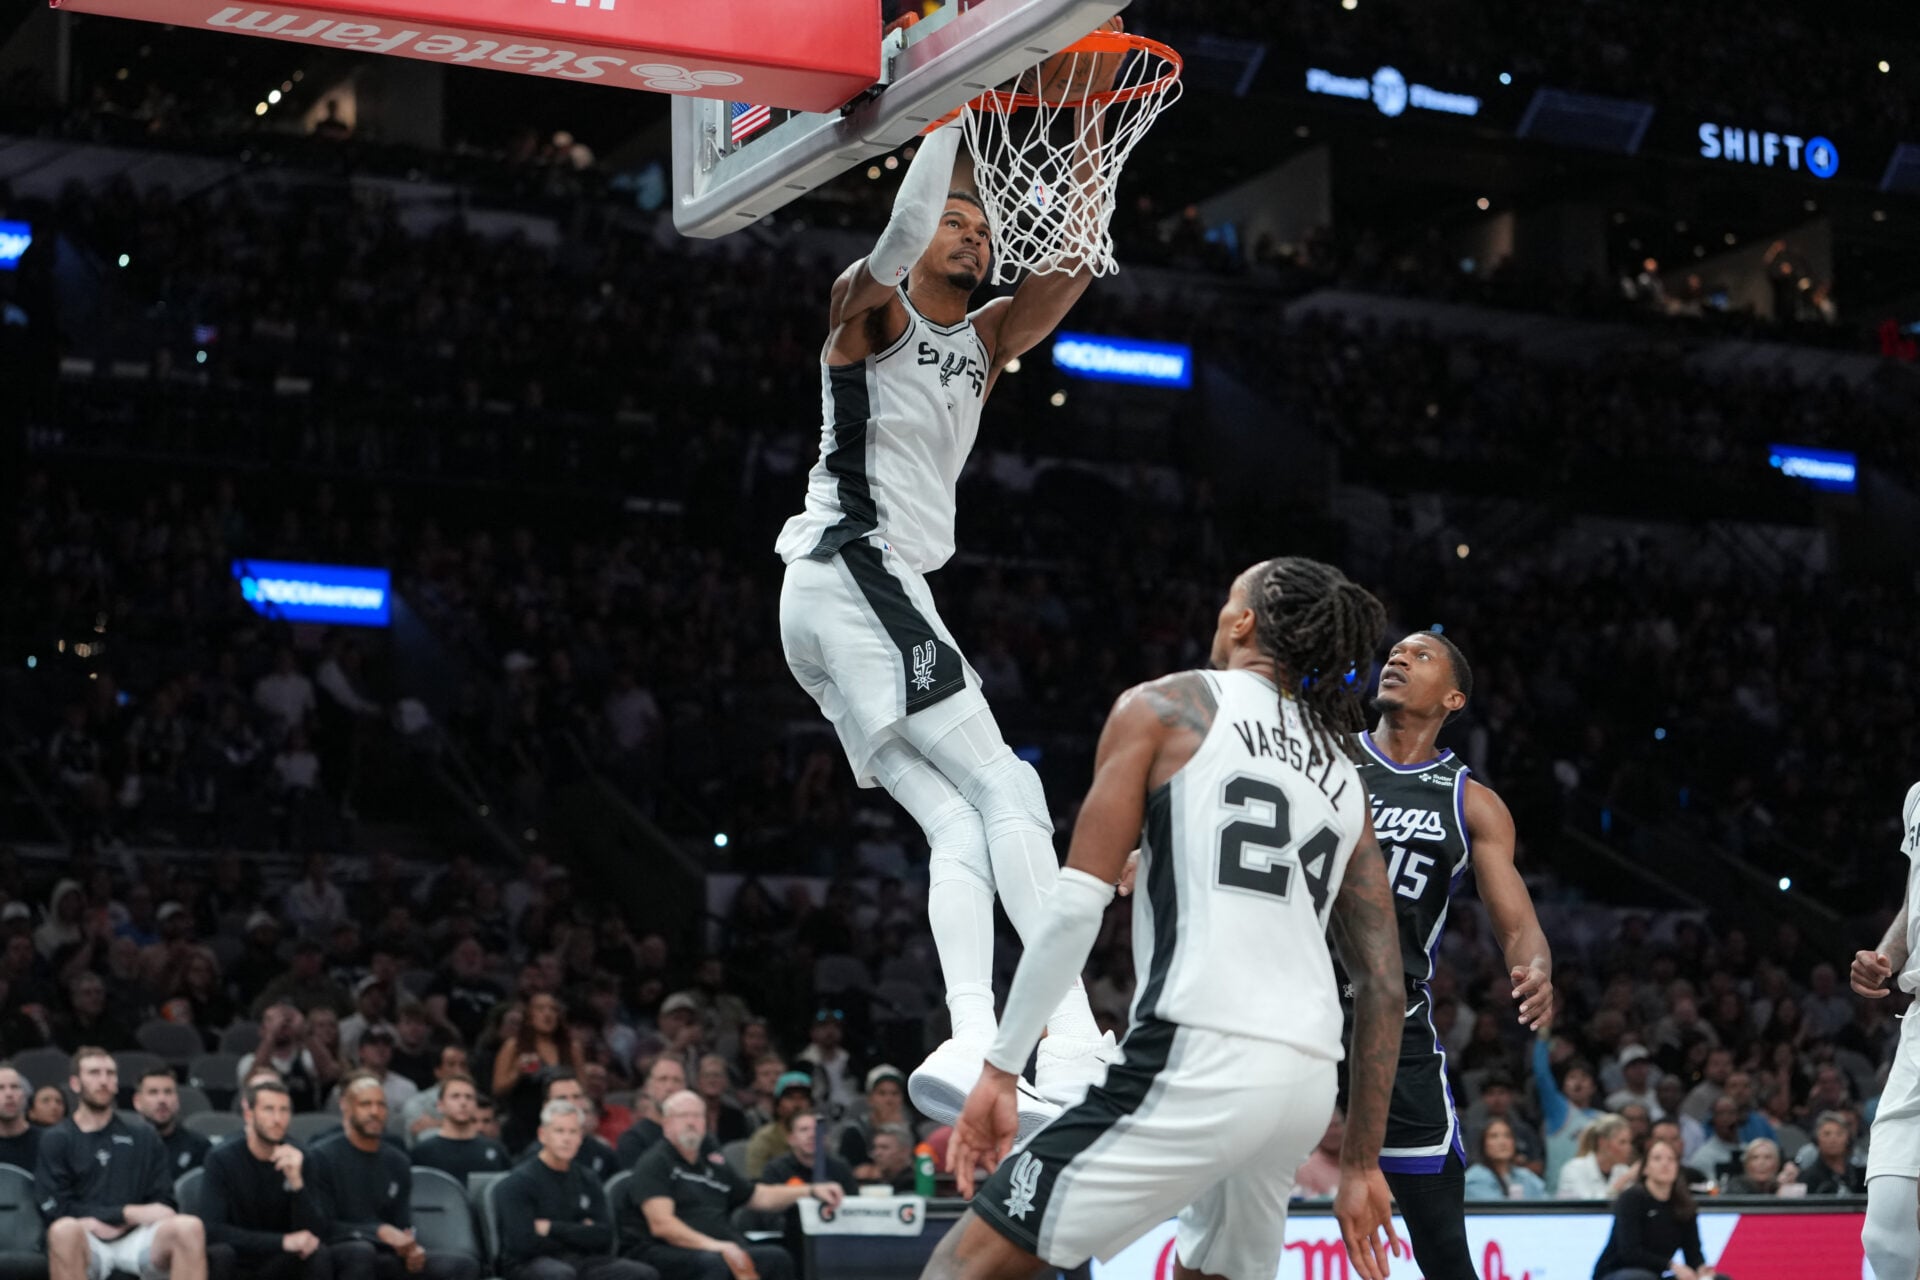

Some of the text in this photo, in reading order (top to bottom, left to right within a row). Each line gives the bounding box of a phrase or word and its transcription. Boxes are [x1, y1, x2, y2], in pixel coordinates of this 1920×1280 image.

[1233, 720, 1347, 812] VASSELL
[1212, 770, 1346, 928] 24
[1368, 793, 1447, 842] ings
[1387, 844, 1436, 900] 15
